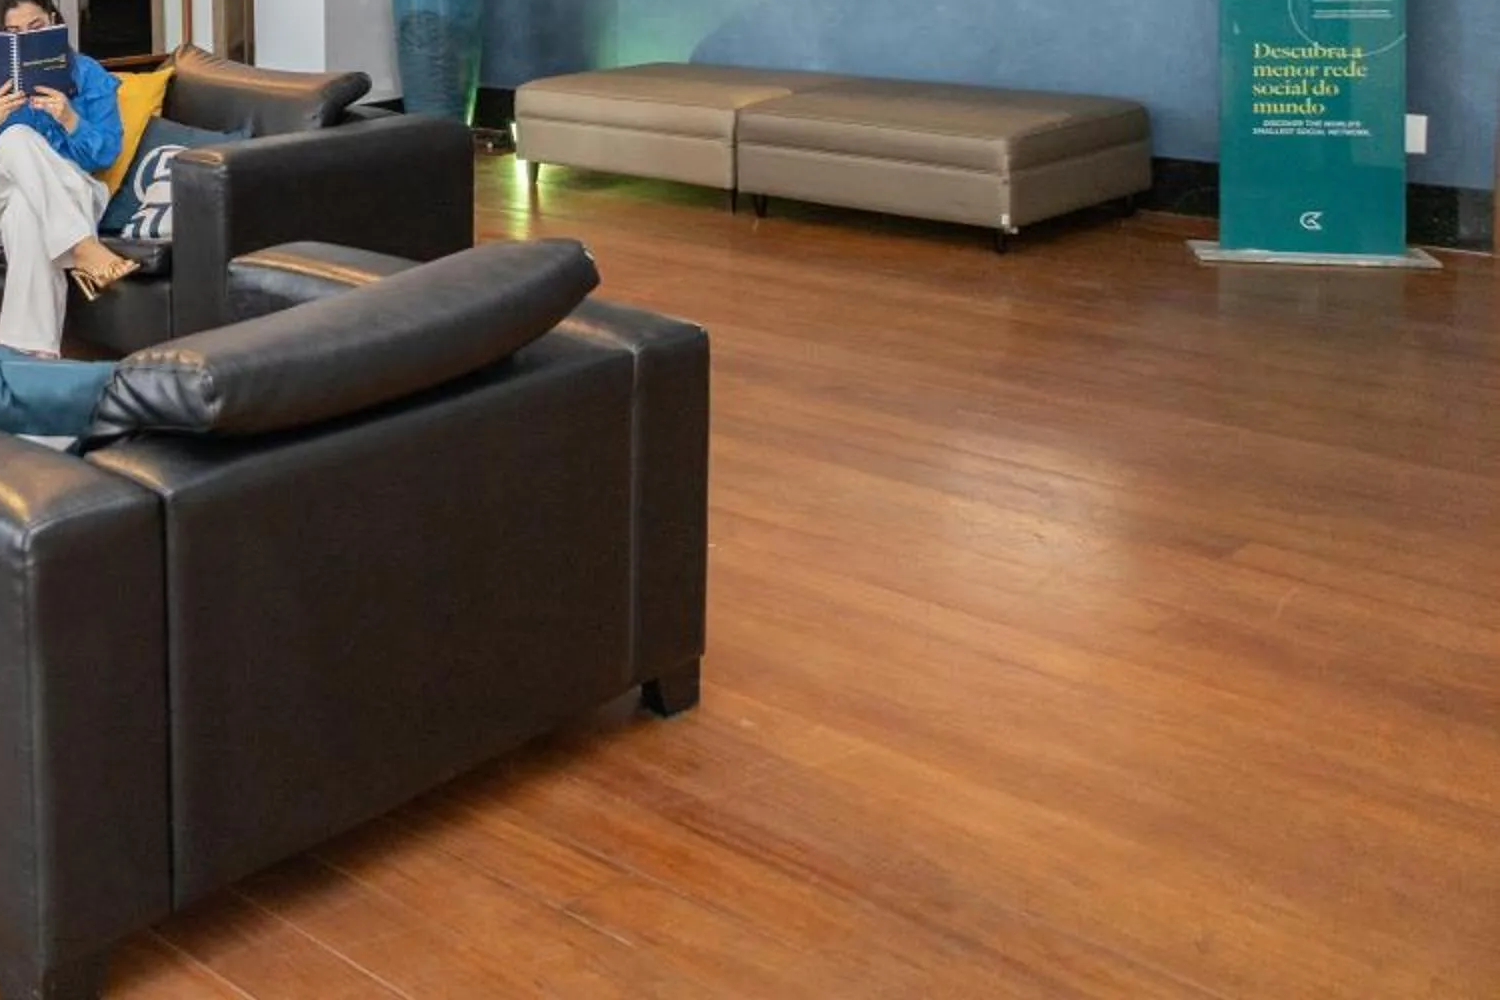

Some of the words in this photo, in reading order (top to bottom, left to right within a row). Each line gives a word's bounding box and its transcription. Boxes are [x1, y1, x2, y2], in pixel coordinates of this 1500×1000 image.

[1254, 42, 1347, 59] Descubra
[1351, 47, 1362, 58] a
[1252, 65, 1319, 77] menor
[1323, 61, 1368, 77] rede
[1252, 80, 1307, 96] social
[1312, 80, 1340, 96] do
[1252, 97, 1325, 114] mundo
